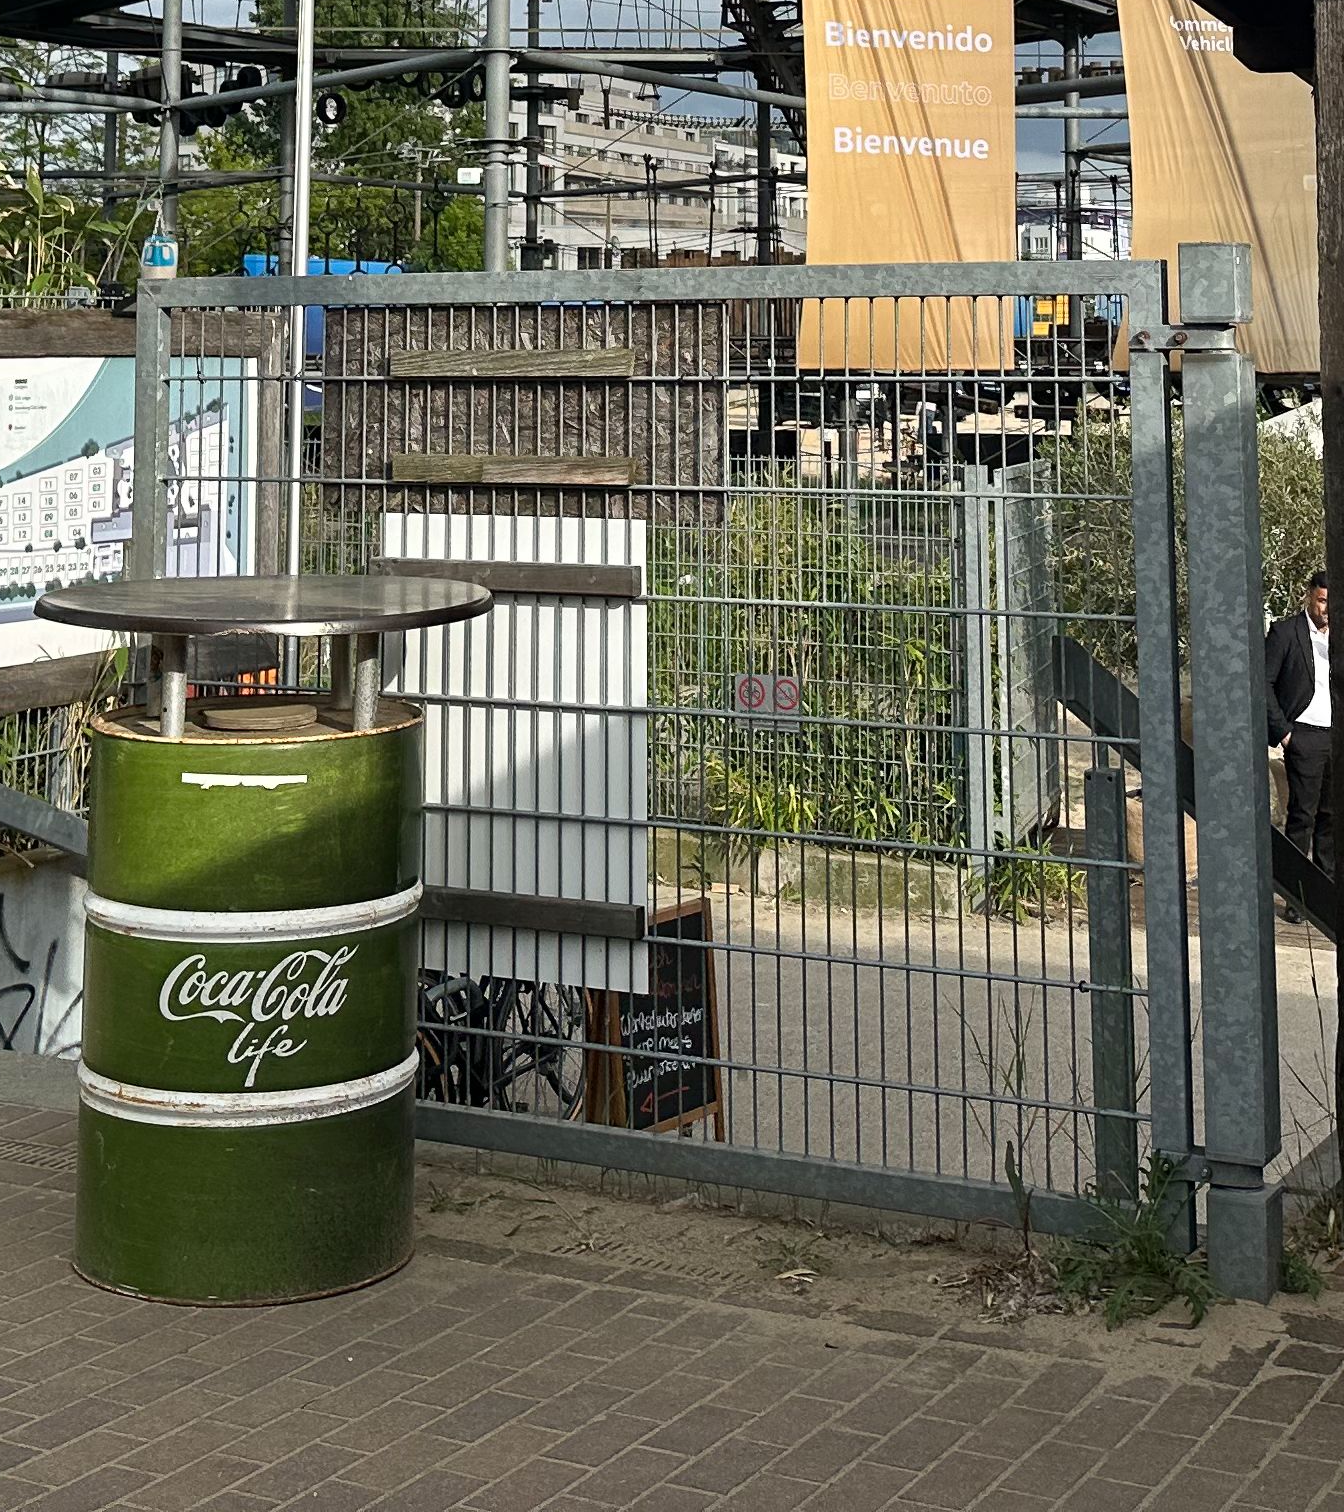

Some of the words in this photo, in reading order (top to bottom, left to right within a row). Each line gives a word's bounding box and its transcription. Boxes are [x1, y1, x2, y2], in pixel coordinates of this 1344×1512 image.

[824, 20, 993, 53] Bienvenido
[828, 73, 992, 105] Benvenuto
[833, 126, 989, 160] Bienvenue
[159, 944, 360, 1023] Coca-Cola
[226, 1023, 308, 1087] life
